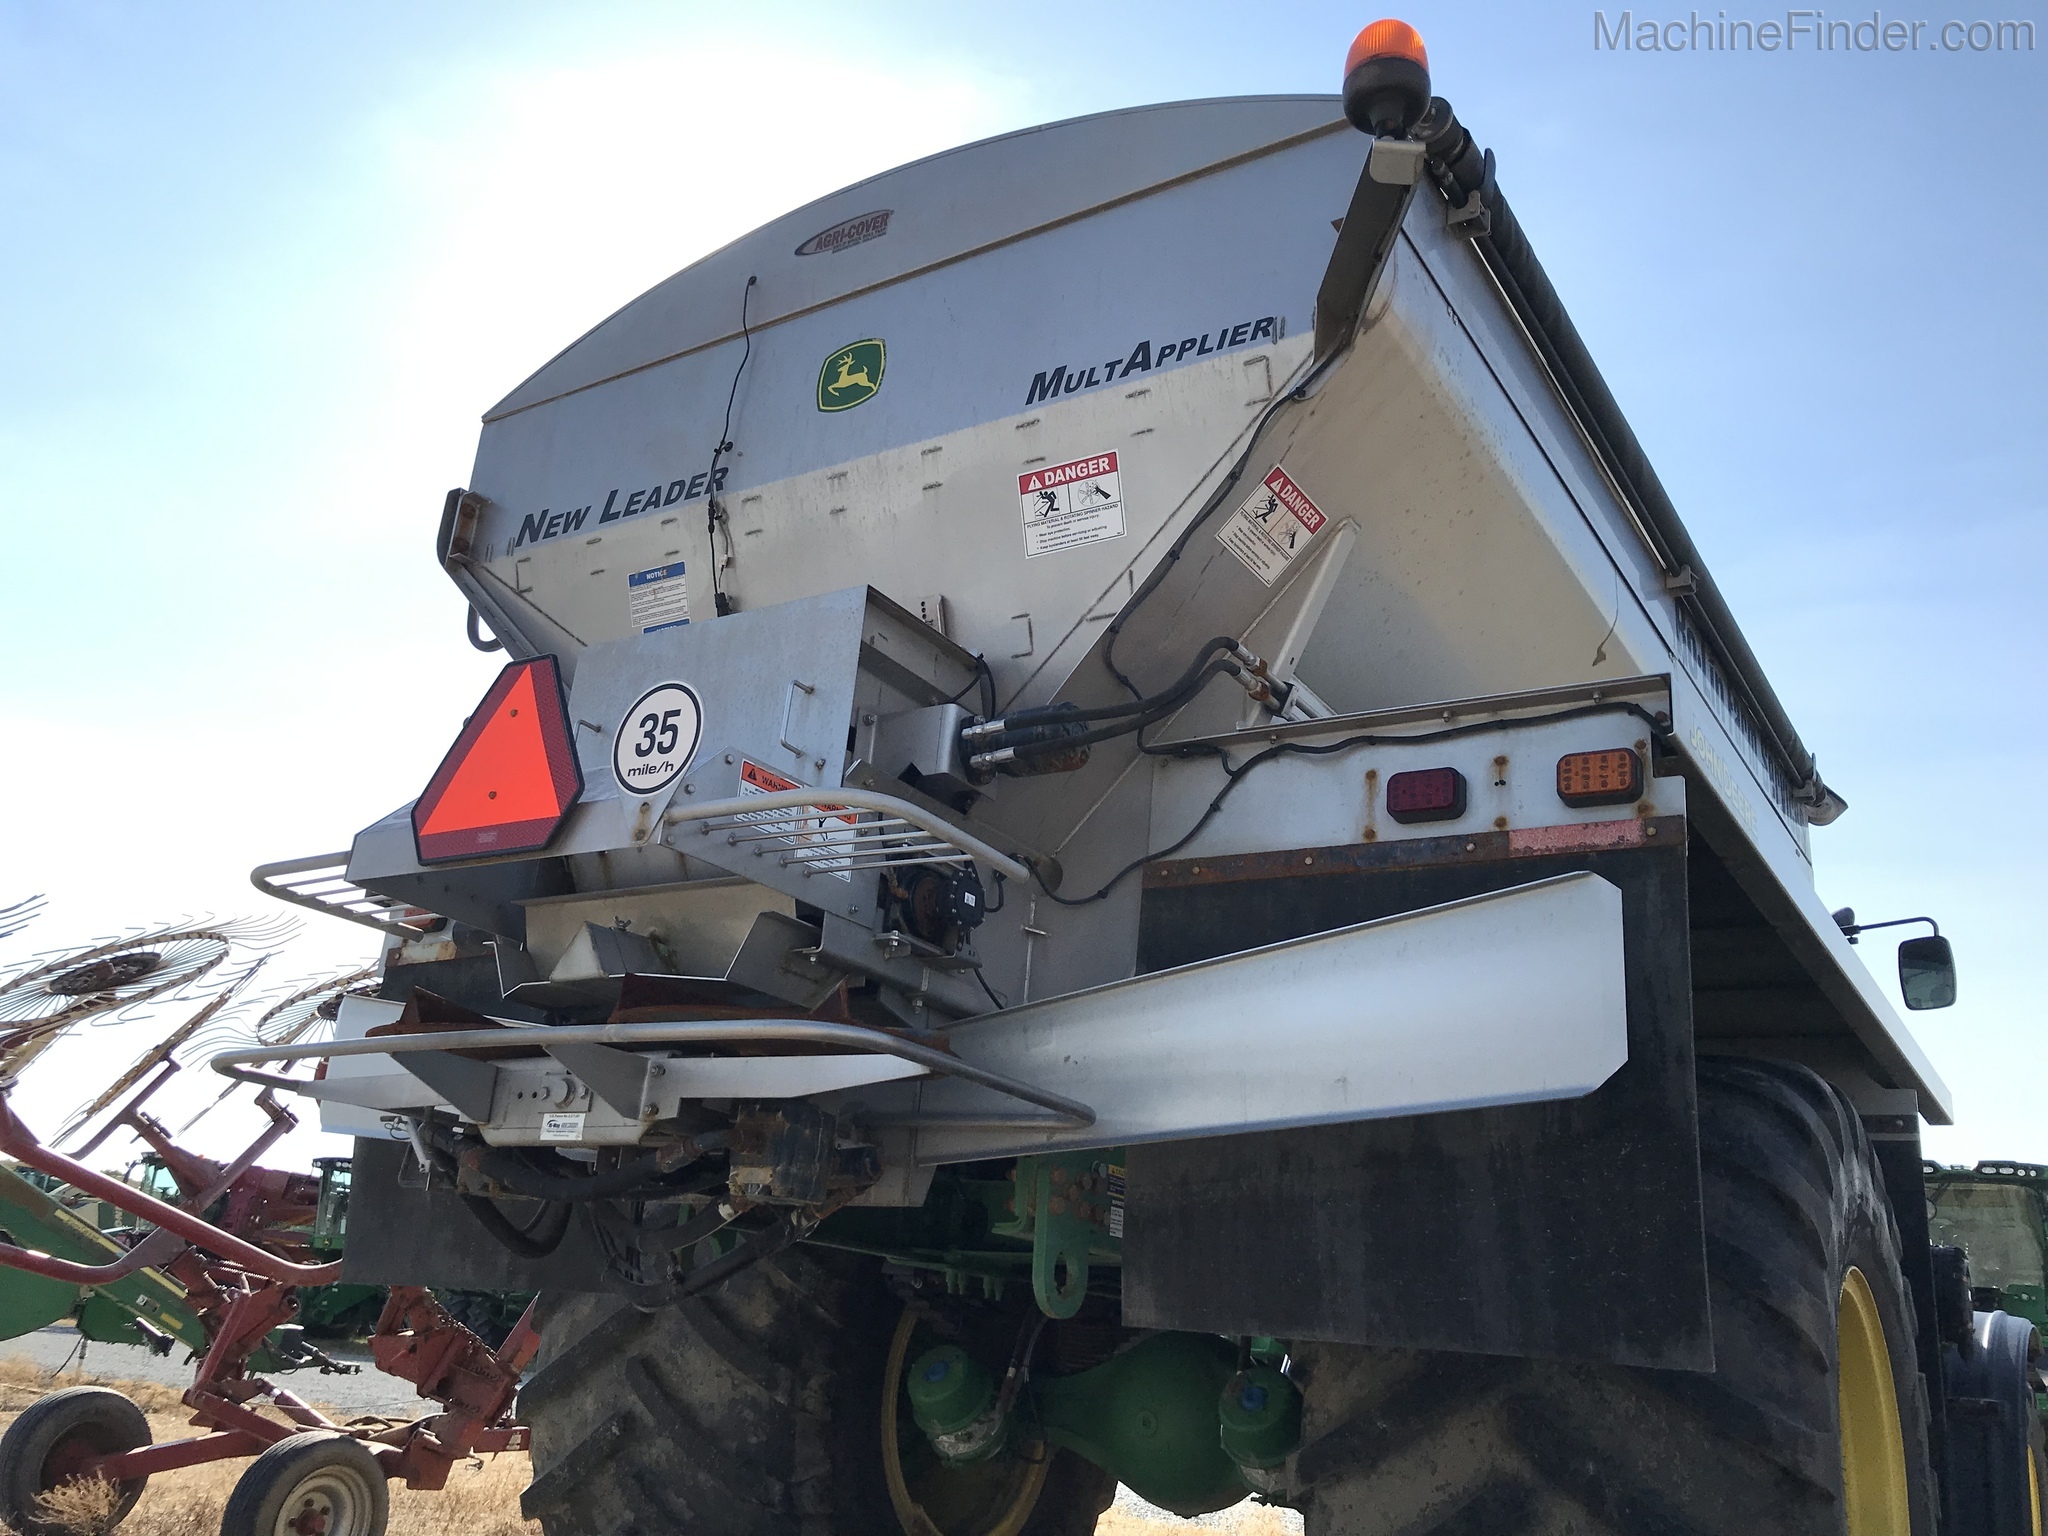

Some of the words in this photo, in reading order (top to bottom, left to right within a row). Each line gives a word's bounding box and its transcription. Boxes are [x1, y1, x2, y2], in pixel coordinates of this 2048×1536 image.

[814, 212, 890, 252] AGRI-COVER
[1044, 457, 1110, 486] DANGER
[514, 505, 592, 547] NEW
[598, 467, 729, 525] LEADER
[1280, 484, 1320, 529] DANGER
[646, 569, 668, 580] NOTICE
[635, 708, 682, 758] 35
[627, 760, 674, 777] mile/h
[1690, 713, 1723, 788] JOHN
[1722, 757, 1758, 841] DEERE
